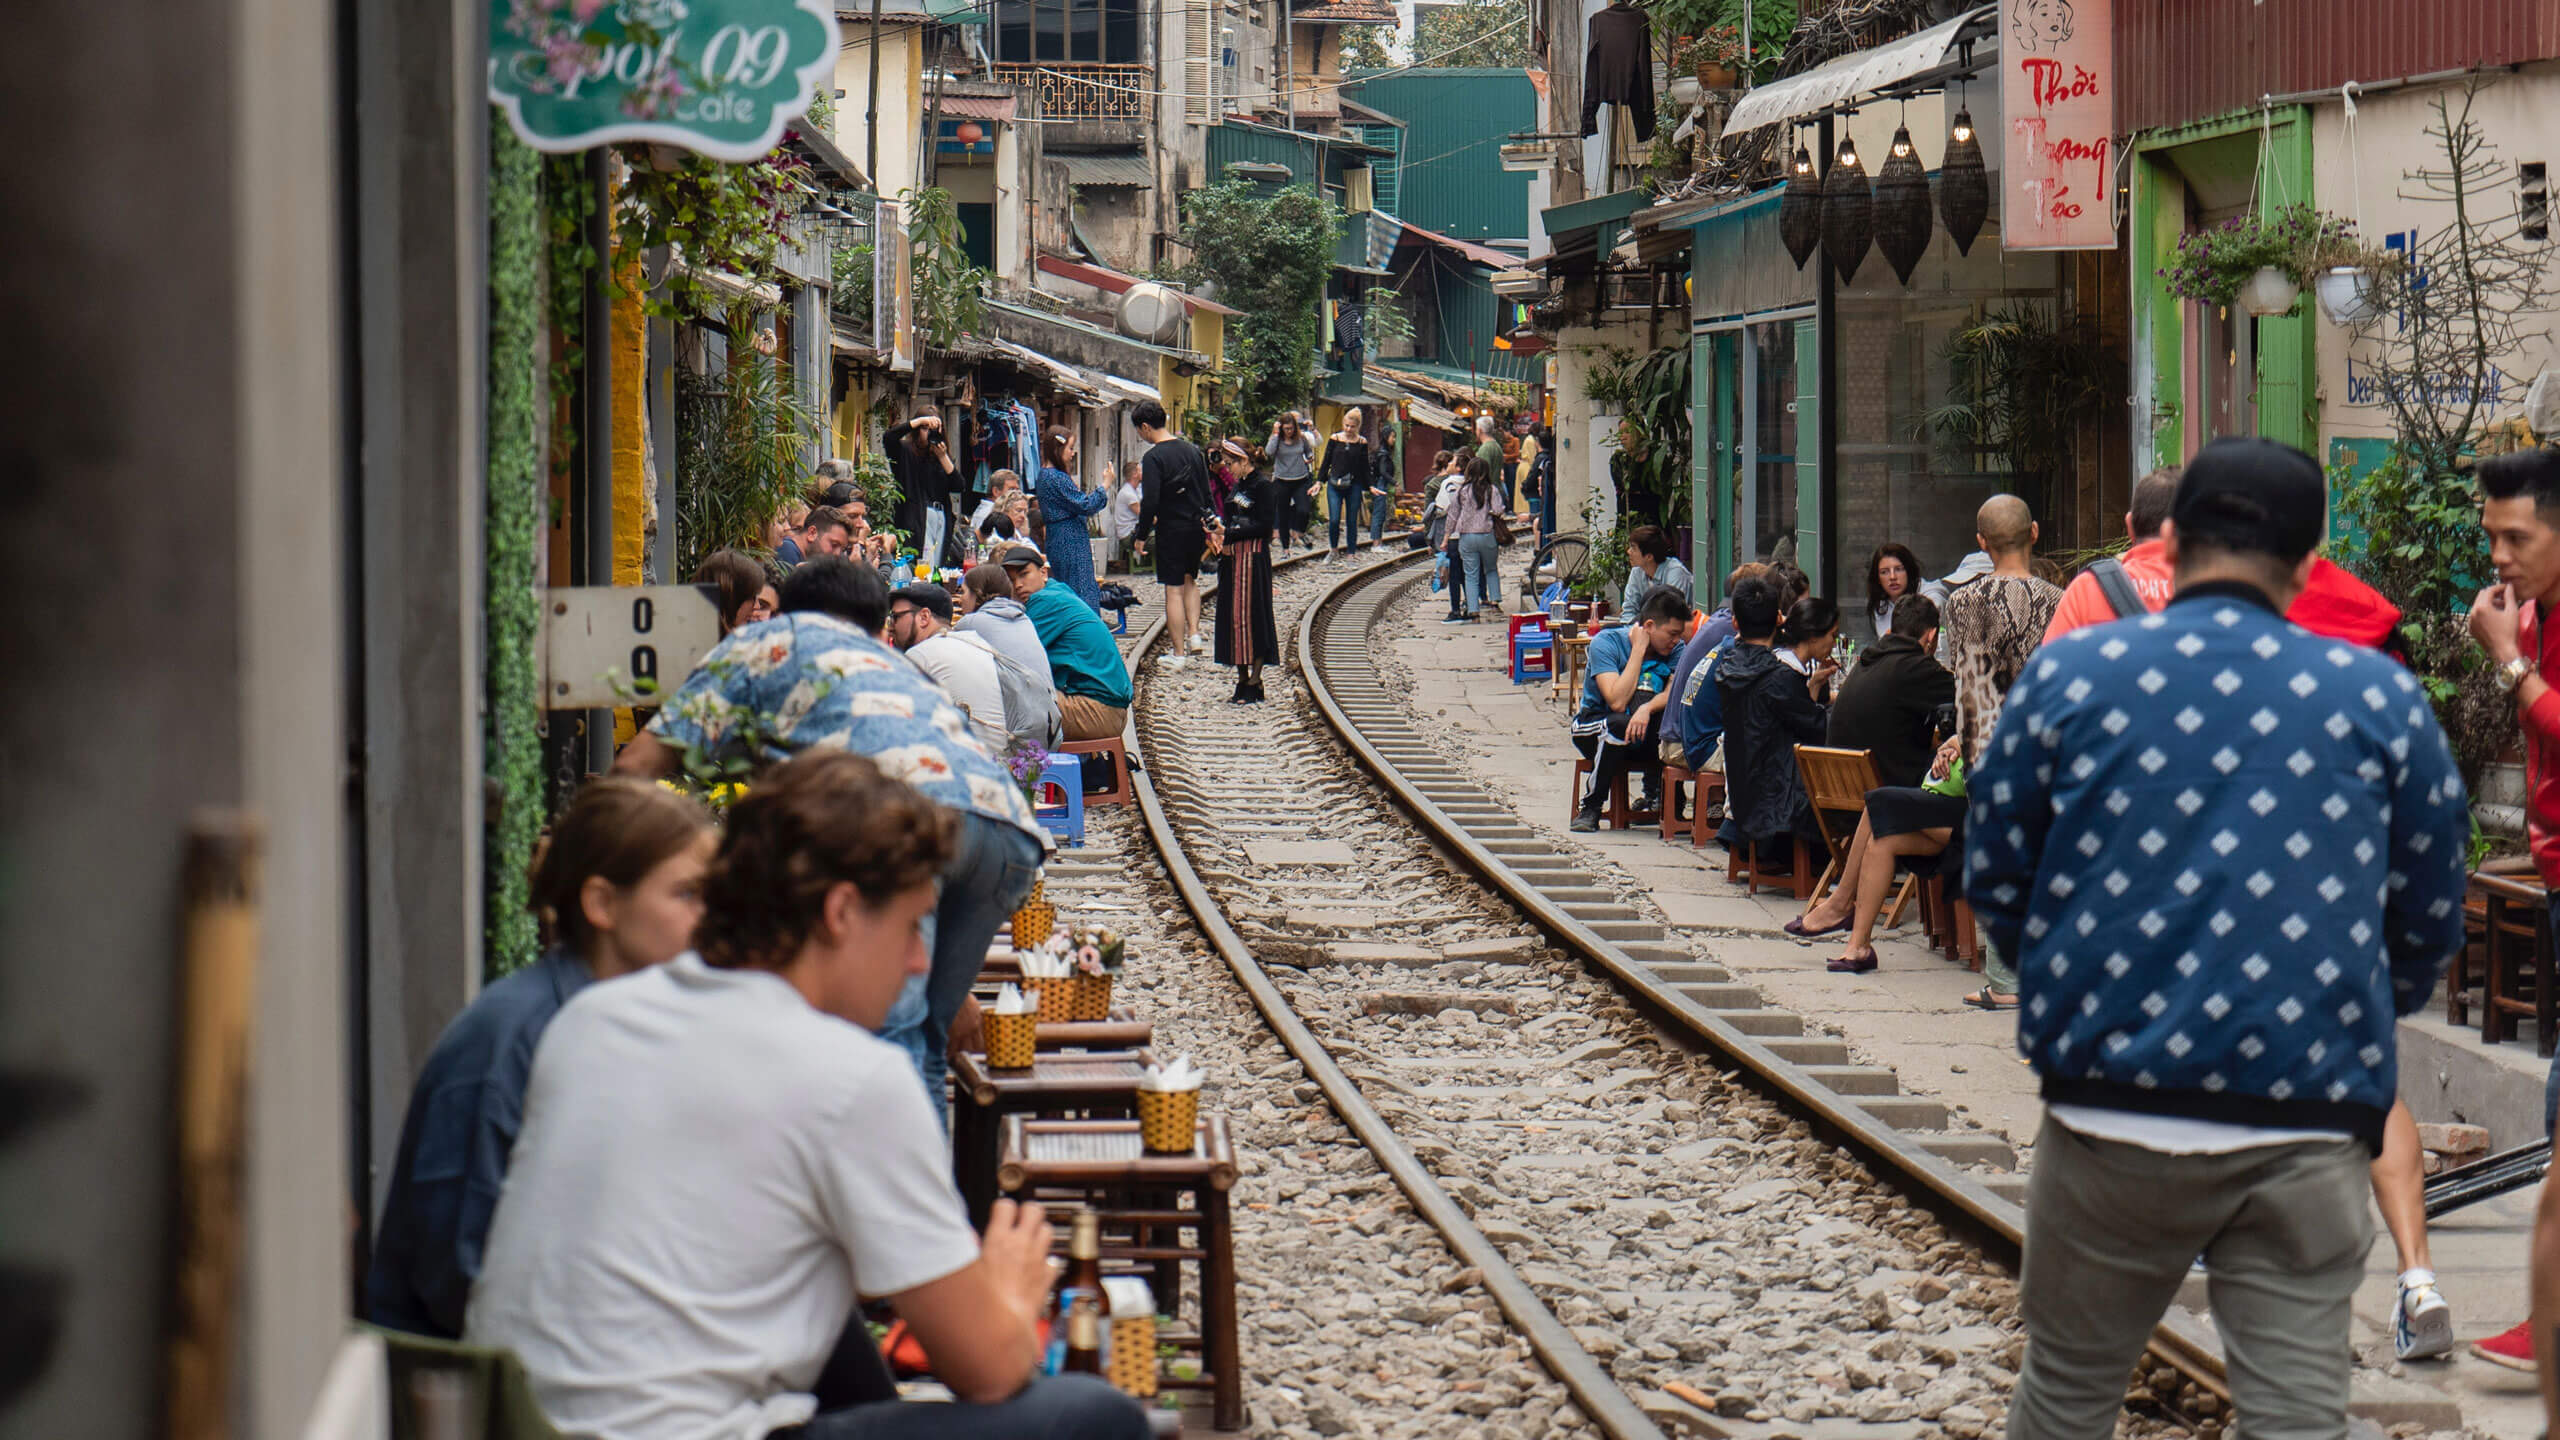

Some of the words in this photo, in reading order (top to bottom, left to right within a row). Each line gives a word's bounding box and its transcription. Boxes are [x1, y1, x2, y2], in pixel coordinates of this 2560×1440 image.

[700, 23, 790, 89] 09
[2021, 57, 2099, 108] Thời
[2014, 118, 2108, 201] Trang
[2022, 178, 2084, 230] Tóc
